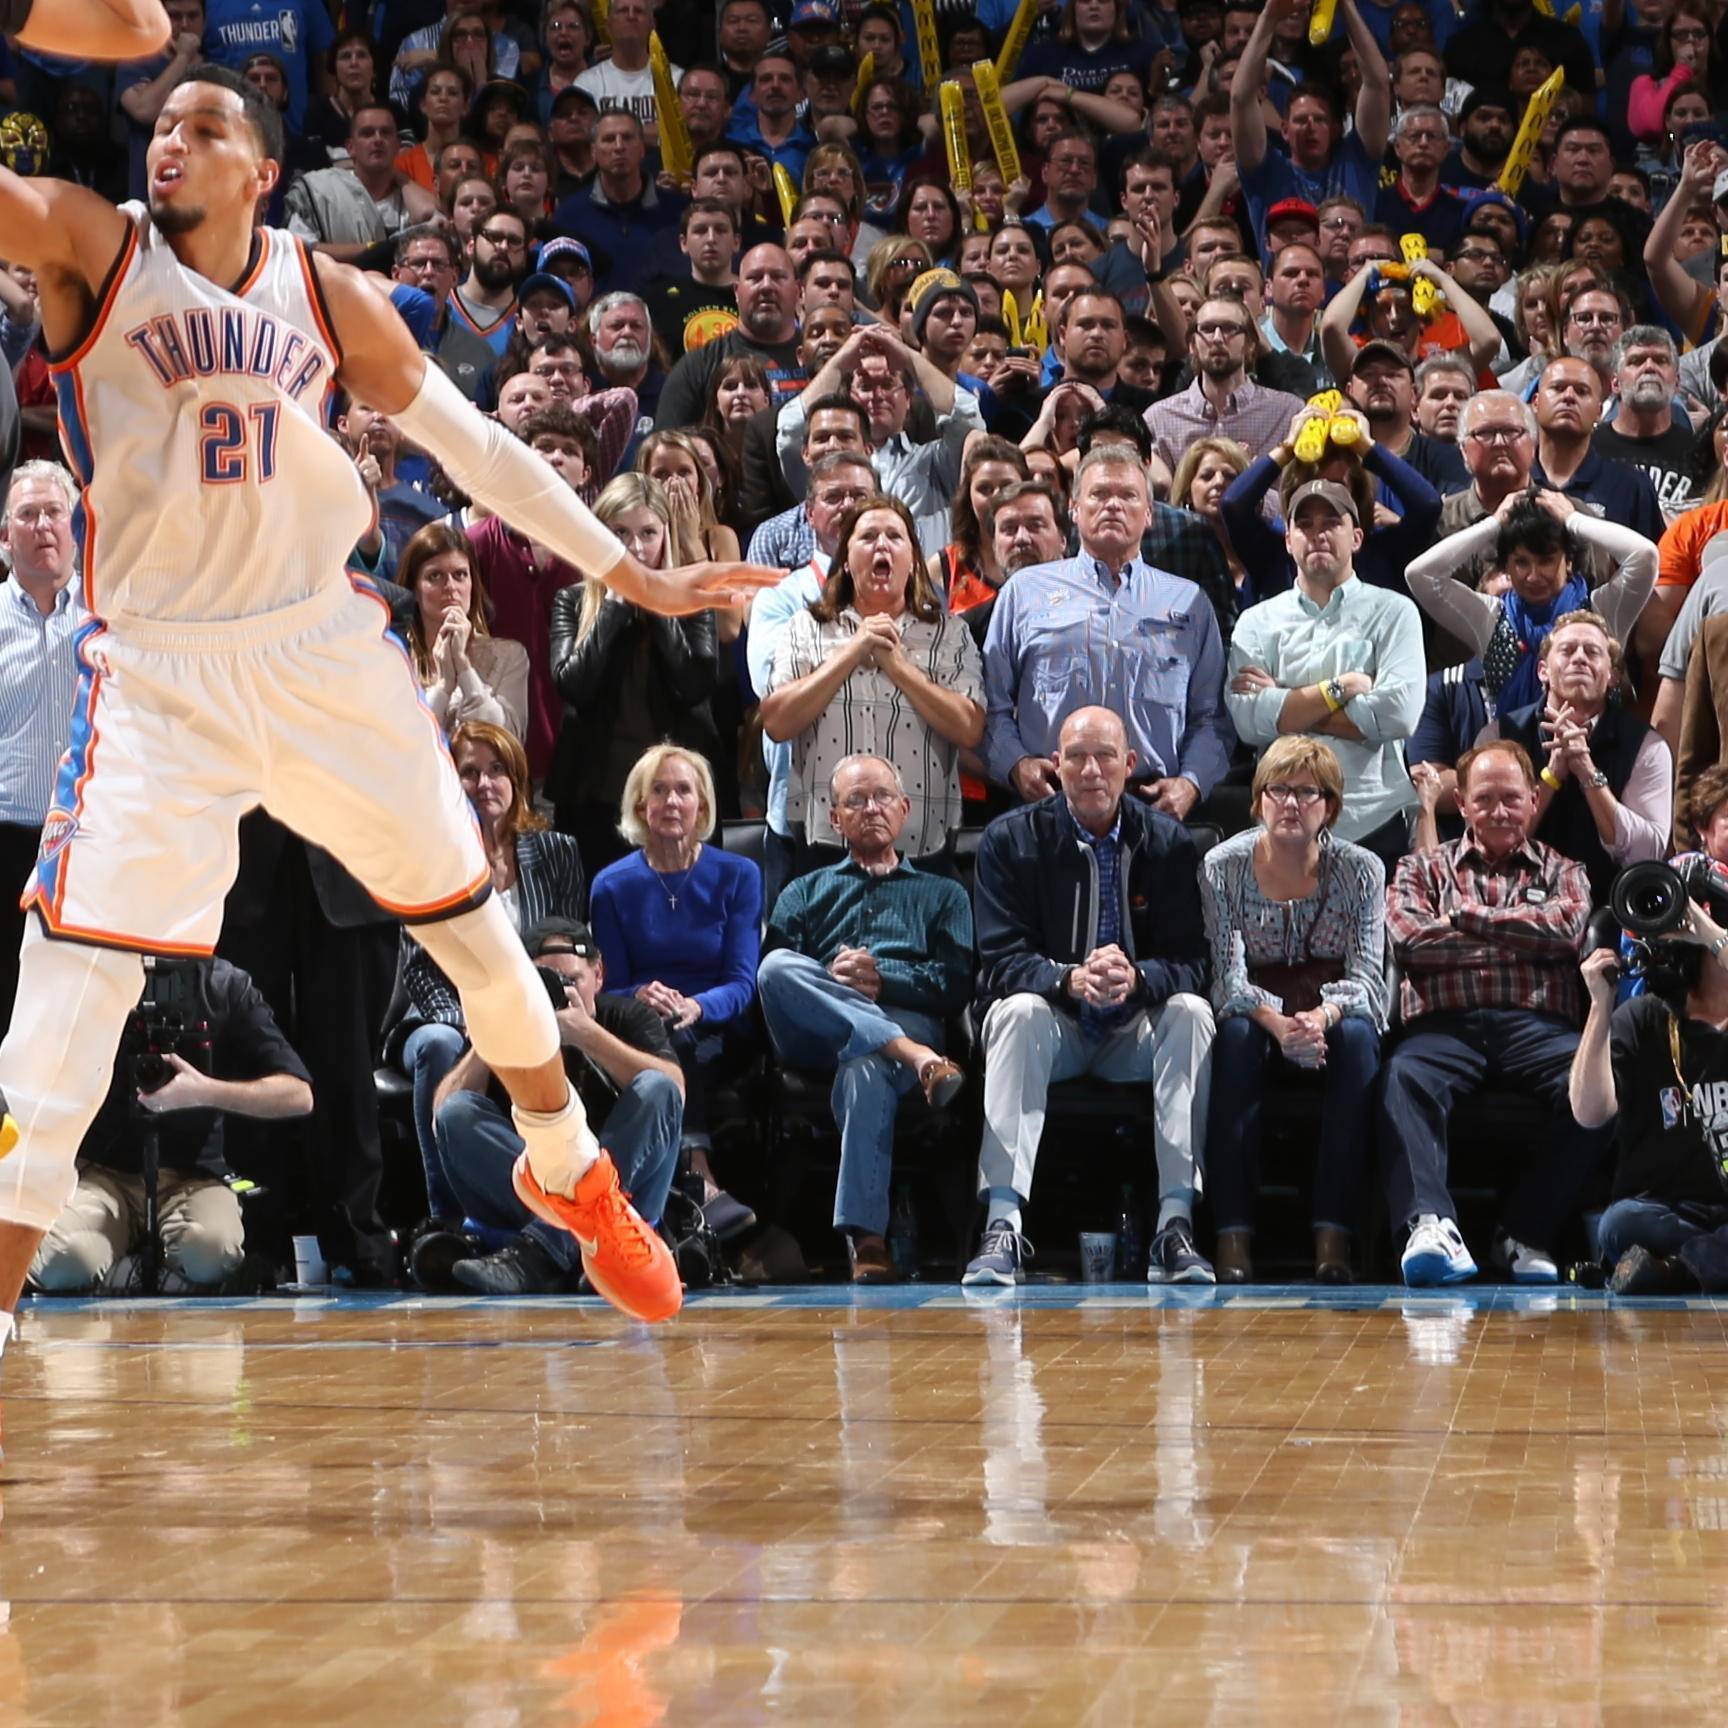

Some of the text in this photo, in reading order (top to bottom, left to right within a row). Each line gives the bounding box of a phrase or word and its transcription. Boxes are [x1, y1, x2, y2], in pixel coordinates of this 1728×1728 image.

[218, 20, 281, 46] THUNDER
[126, 311, 328, 402] THUNDER
[198, 401, 283, 485] 21
